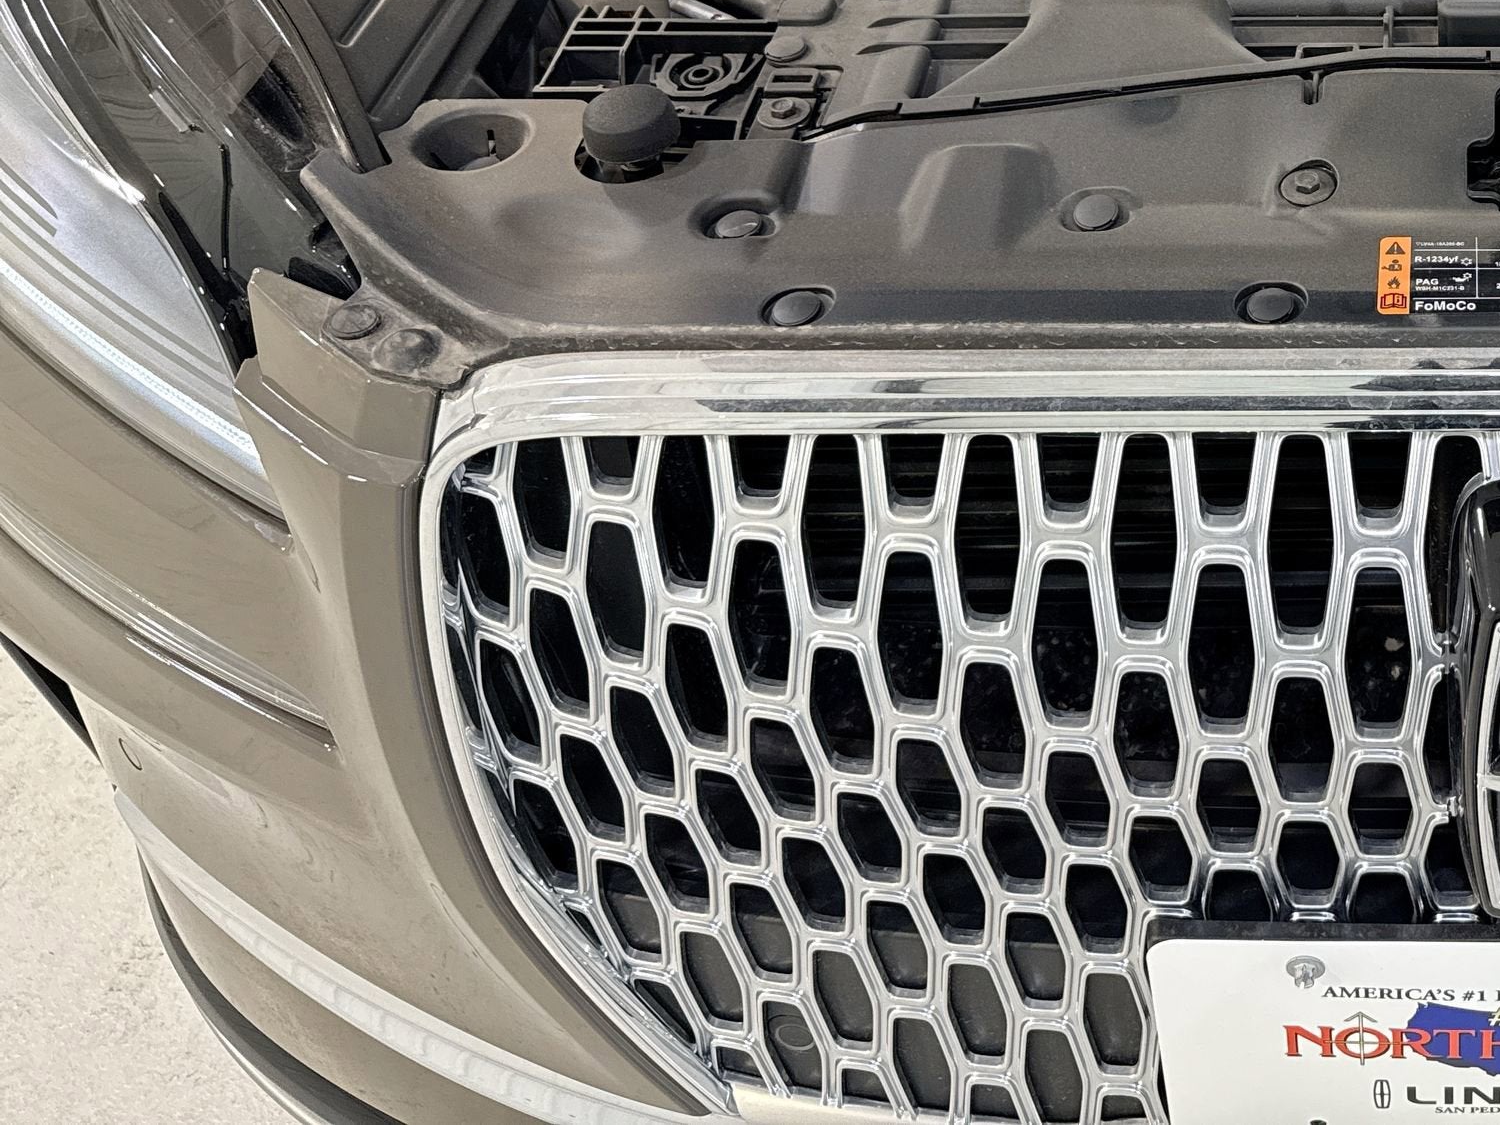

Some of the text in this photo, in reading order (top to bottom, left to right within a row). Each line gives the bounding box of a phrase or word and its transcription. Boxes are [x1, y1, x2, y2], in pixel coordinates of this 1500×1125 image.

[1414, 255, 1459, 264] R-1234yf
[1415, 278, 1439, 286] PAG
[1414, 300, 1477, 311] FoMoCo
[1321, 985, 1456, 1002] AMERICA'S
[1462, 989, 1488, 1002] #1
[1435, 1105, 1466, 1114] SAN
